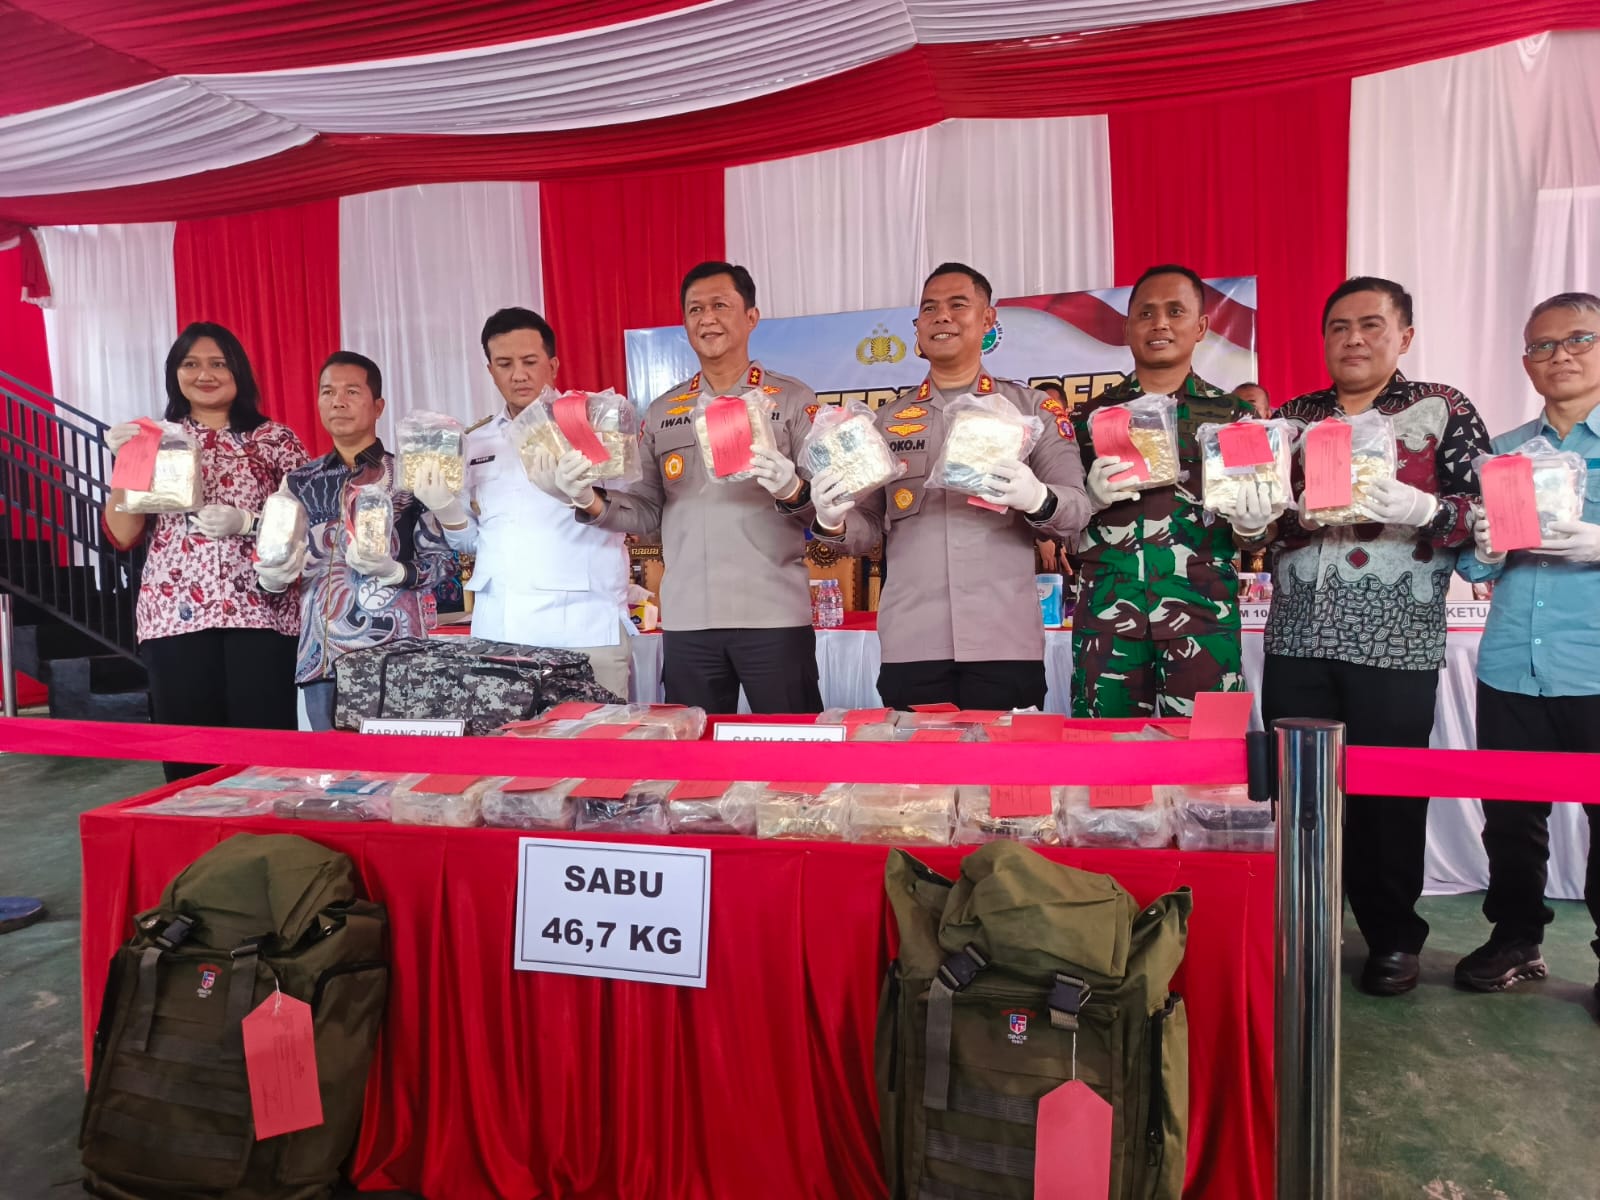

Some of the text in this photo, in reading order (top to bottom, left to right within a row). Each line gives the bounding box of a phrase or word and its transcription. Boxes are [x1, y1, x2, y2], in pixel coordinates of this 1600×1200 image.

[890, 440, 925, 452] OKO.H
[1240, 609, 1268, 618] M 10
[1446, 607, 1487, 618] KETU
[564, 865, 664, 898] SABU
[541, 917, 682, 954] 46,7 KG
